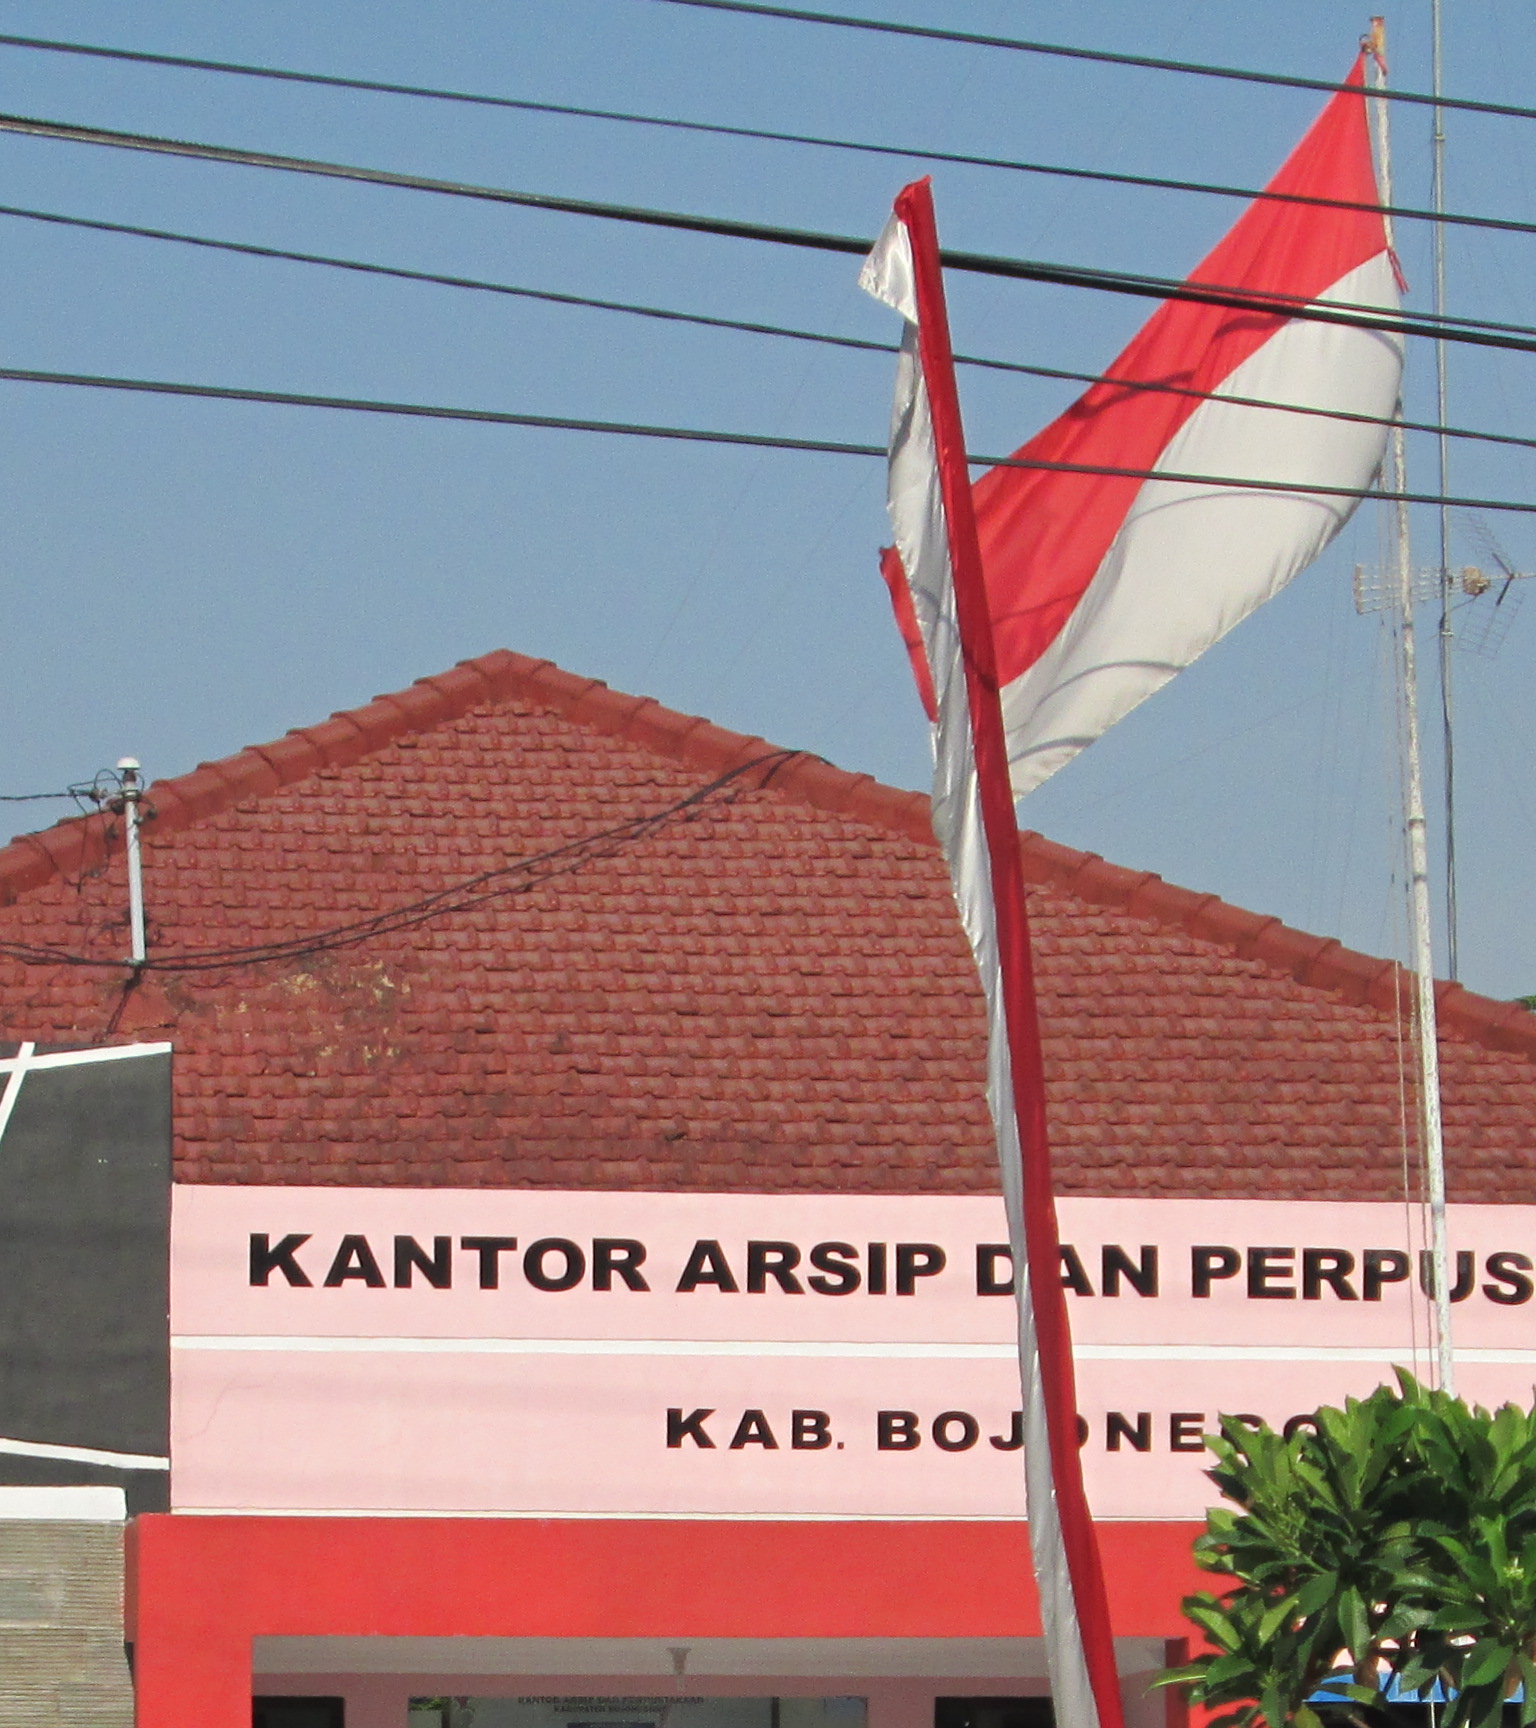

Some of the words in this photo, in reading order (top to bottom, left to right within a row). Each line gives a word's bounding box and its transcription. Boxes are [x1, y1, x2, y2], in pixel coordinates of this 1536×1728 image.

[249, 1232, 651, 1293] KANTOR
[676, 1241, 947, 1296] ARSIP
[976, 1244, 1158, 1297] DAN
[667, 1408, 846, 1451] KAB.
